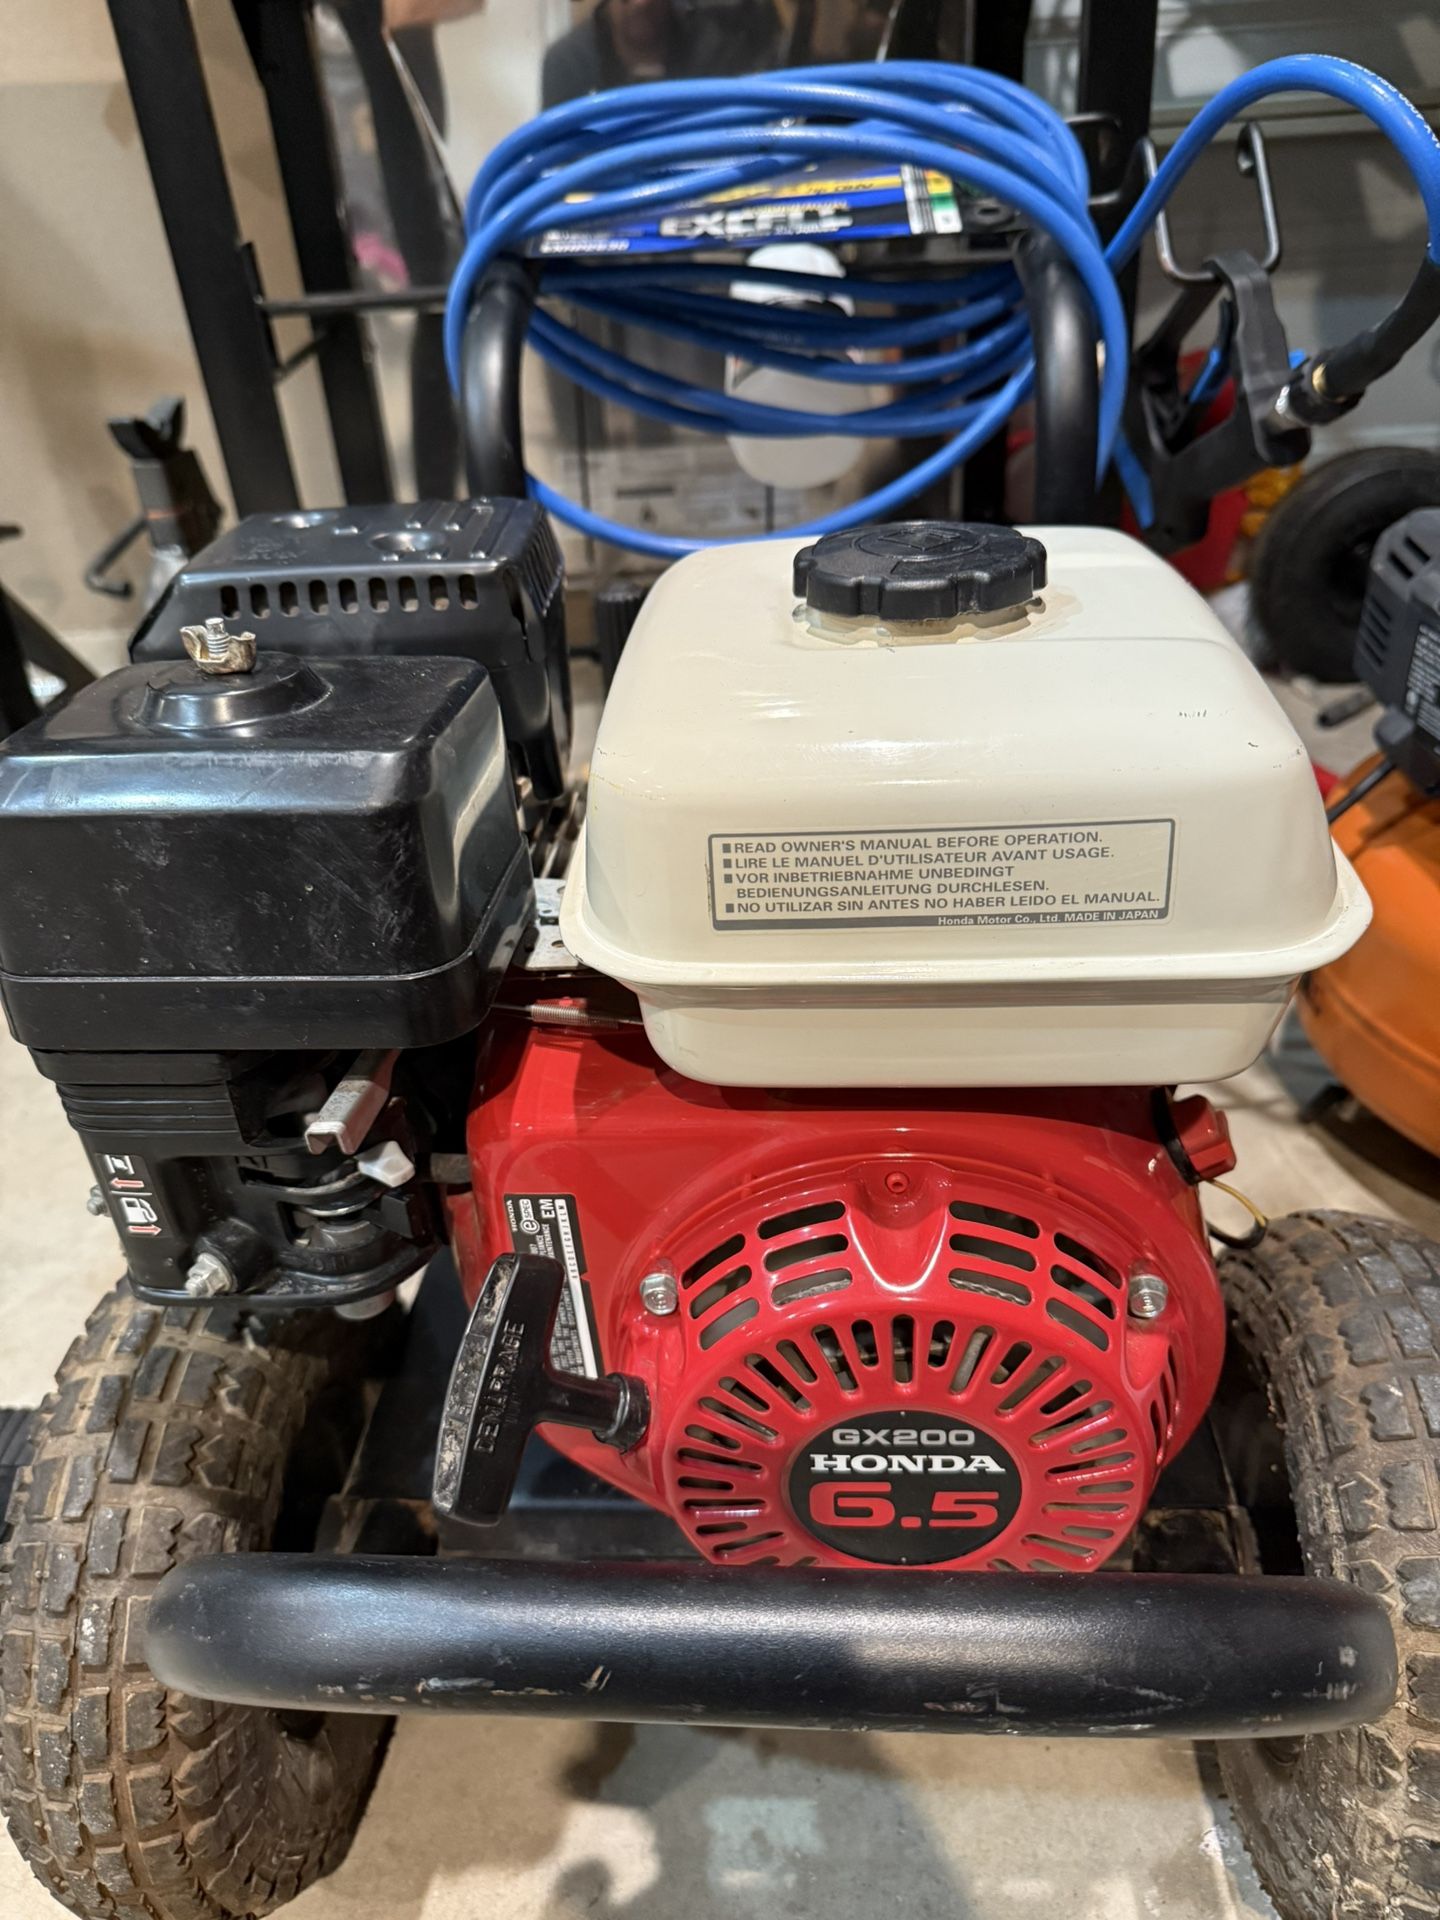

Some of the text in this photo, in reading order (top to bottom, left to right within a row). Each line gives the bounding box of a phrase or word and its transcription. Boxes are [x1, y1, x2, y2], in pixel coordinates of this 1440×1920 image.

[735, 831, 1102, 853] READ OWNER'S MANUAL BEFORE OPERATION.
[735, 846, 1114, 869] LIRE LE MANUEL D'UTILISATEUR AVANT USAGE.
[736, 866, 1014, 884] VOR INBETRIEBNAHME UNBEDINGT
[737, 880, 1049, 899] BEDIENUNGSANLEITUNG DURCHLESEN.
[737, 891, 1160, 913] NO UTILIZAR SIN ANTES NO HABER LEIDO EL MANUAL.
[938, 916, 974, 926] Honda
[977, 915, 1011, 925] Motor
[1039, 913, 1061, 923] Ltd.
[1064, 912, 1100, 922] MADE
[1103, 911, 1116, 921] IN
[1119, 910, 1159, 920] JAPAN
[506, 1199, 518, 1232] HONDA
[539, 1198, 556, 1219] EM
[832, 1428, 976, 1447] GX200
[809, 1453, 1007, 1474] HONDA
[809, 1481, 999, 1529] 6.5
